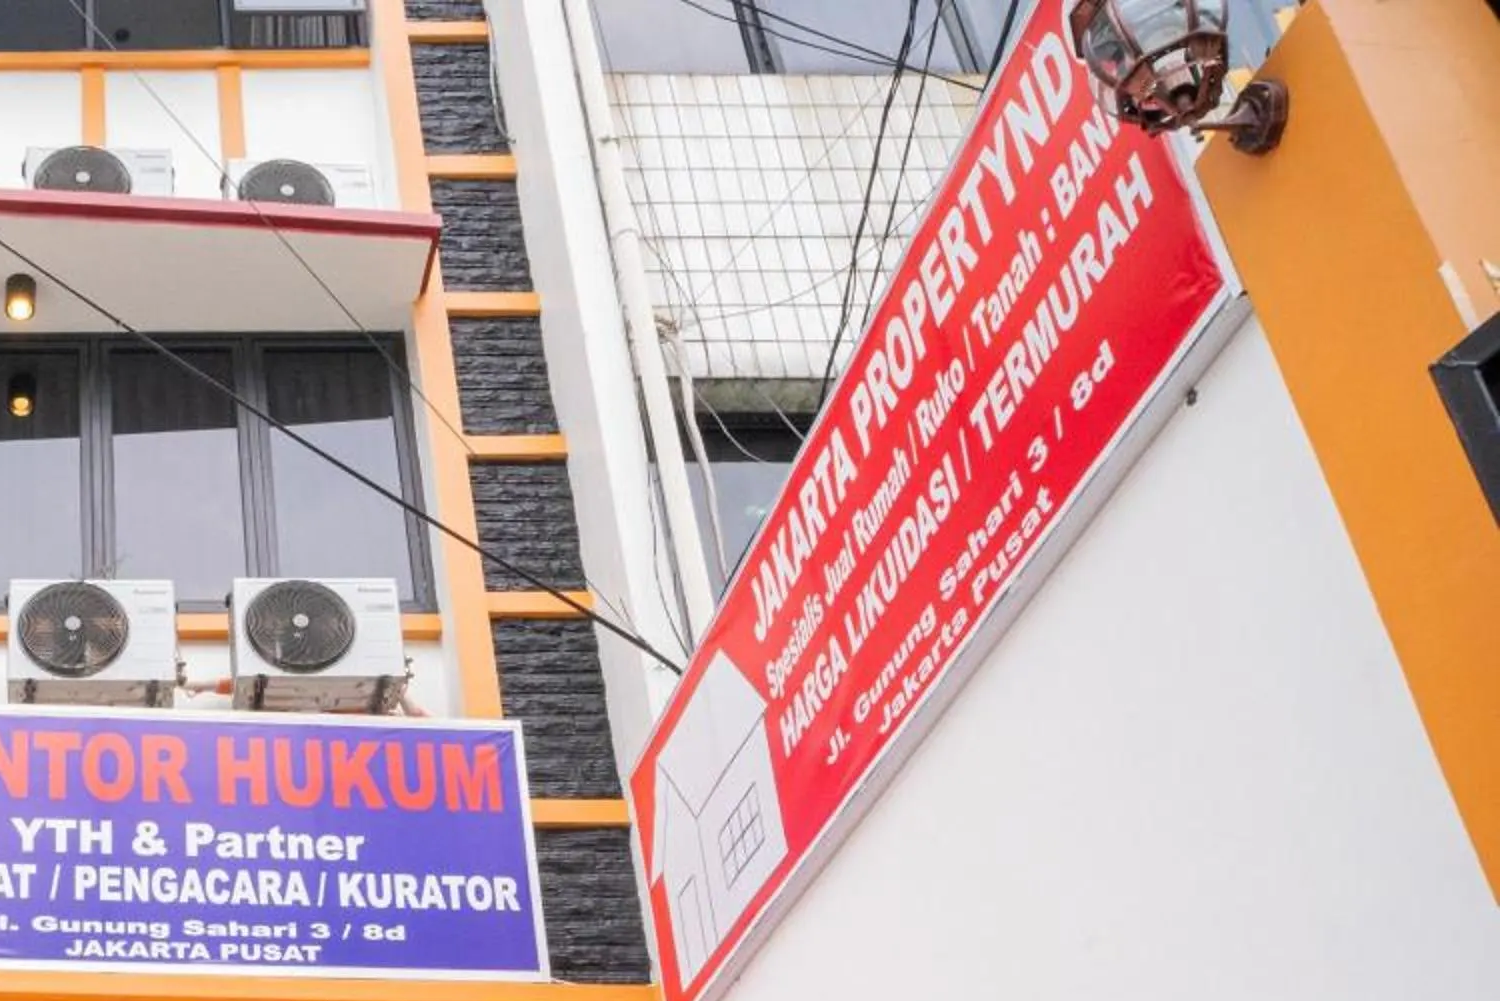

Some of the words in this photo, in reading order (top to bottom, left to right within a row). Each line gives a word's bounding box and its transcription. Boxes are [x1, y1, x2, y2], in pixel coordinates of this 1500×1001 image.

[751, 426, 858, 643] JAKARTA
[850, 0, 1087, 459] PROPERTYND
[765, 593, 824, 699] Spesialis
[824, 530, 856, 606] Jual
[852, 447, 911, 555] Rumah
[908, 420, 919, 465] /
[915, 357, 965, 448] Ruko
[963, 324, 975, 372] /
[971, 228, 1043, 347] Tanah
[780, 634, 848, 758] HARGA
[844, 452, 960, 656] LIKUIDASI
[959, 427, 972, 481] /
[969, 151, 1155, 452] TERMURAH
[853, 603, 936, 723] Gunung
[939, 470, 1023, 601] Sahari
[1027, 435, 1048, 473] 3
[1054, 405, 1063, 440] /
[1070, 339, 1115, 411] 8d
[878, 607, 968, 734] Jakarta
[972, 485, 1053, 606] Pusat
[10, 817, 113, 855] YTH
[131, 820, 169, 857] &
[185, 822, 364, 861] Partner
[217, 735, 504, 812] HUKUM
[32, 915, 170, 939] Gunung
[183, 919, 297, 938] Sahari
[310, 923, 331, 939] 3
[341, 923, 352, 940] /
[363, 924, 407, 941] 8d
[48, 863, 62, 900] /
[75, 864, 311, 905] PENGACARA
[317, 871, 328, 907] /
[338, 872, 521, 911] KURATOR
[65, 939, 211, 960] JAKARTA
[220, 943, 322, 962] PUSAT
